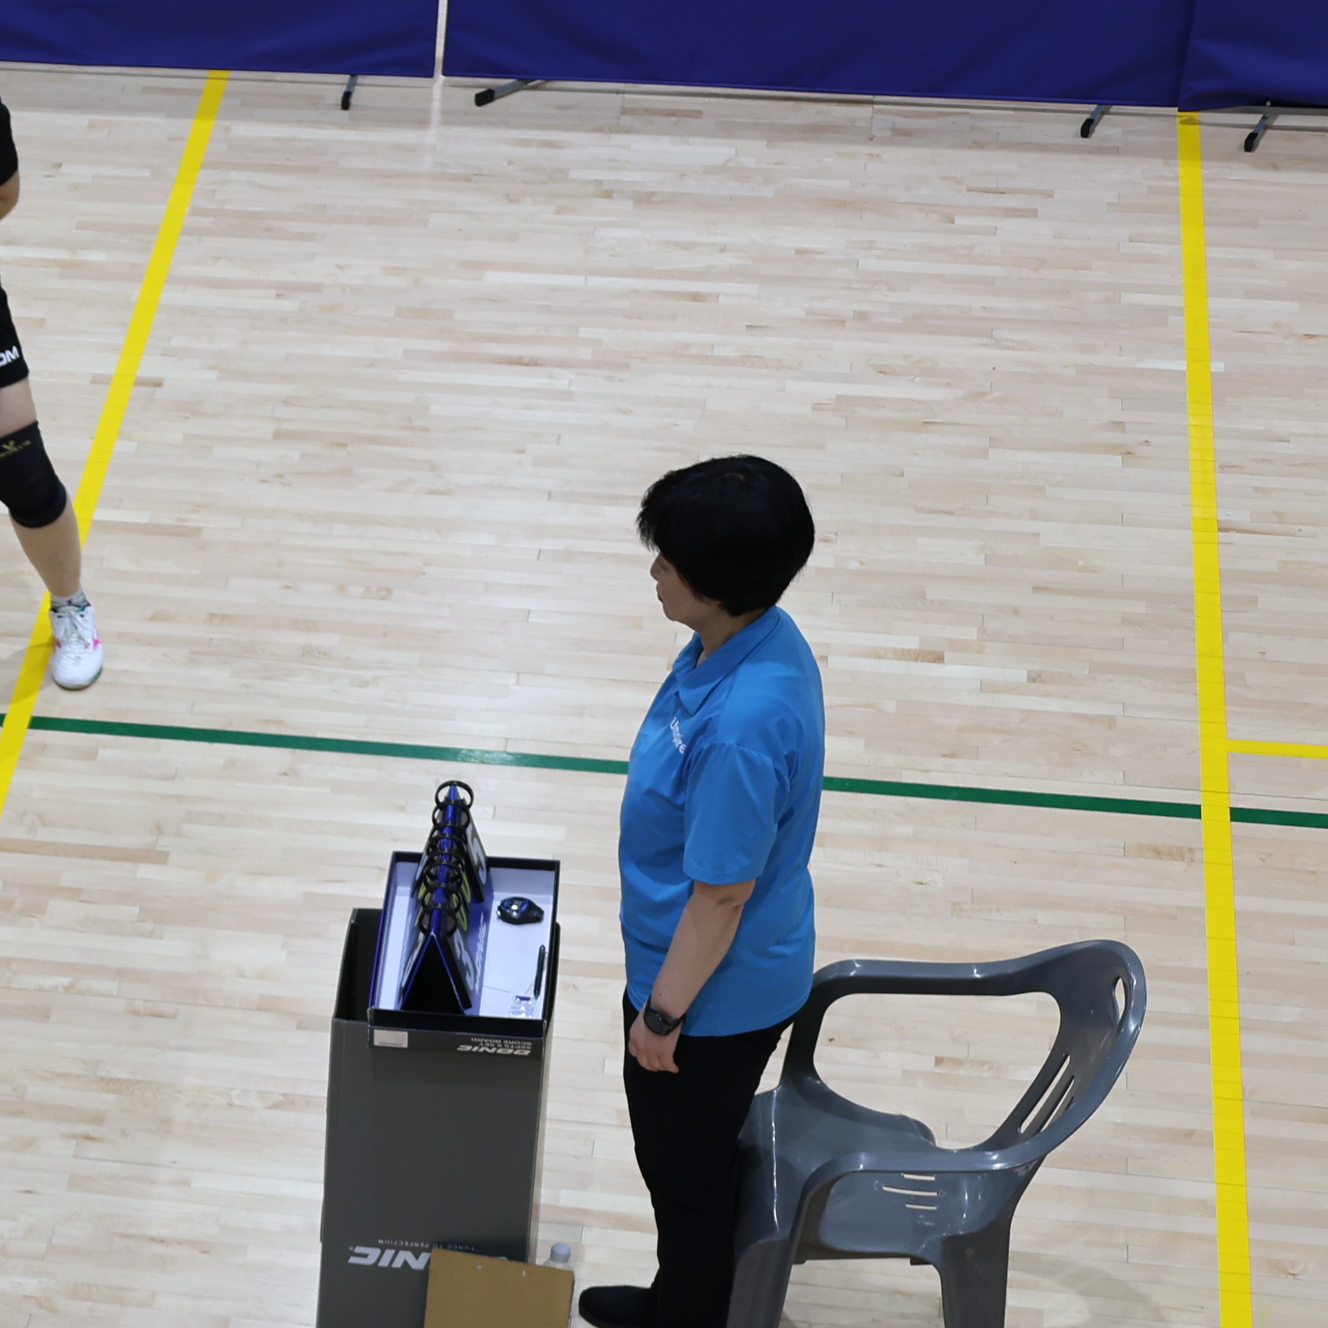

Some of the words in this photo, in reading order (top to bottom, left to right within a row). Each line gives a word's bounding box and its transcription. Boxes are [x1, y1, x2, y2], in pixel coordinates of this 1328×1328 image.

[457, 1044, 531, 1056] DONIC
[378, 1239, 429, 1248] PERFECTION
[348, 1246, 431, 1270] NIC
